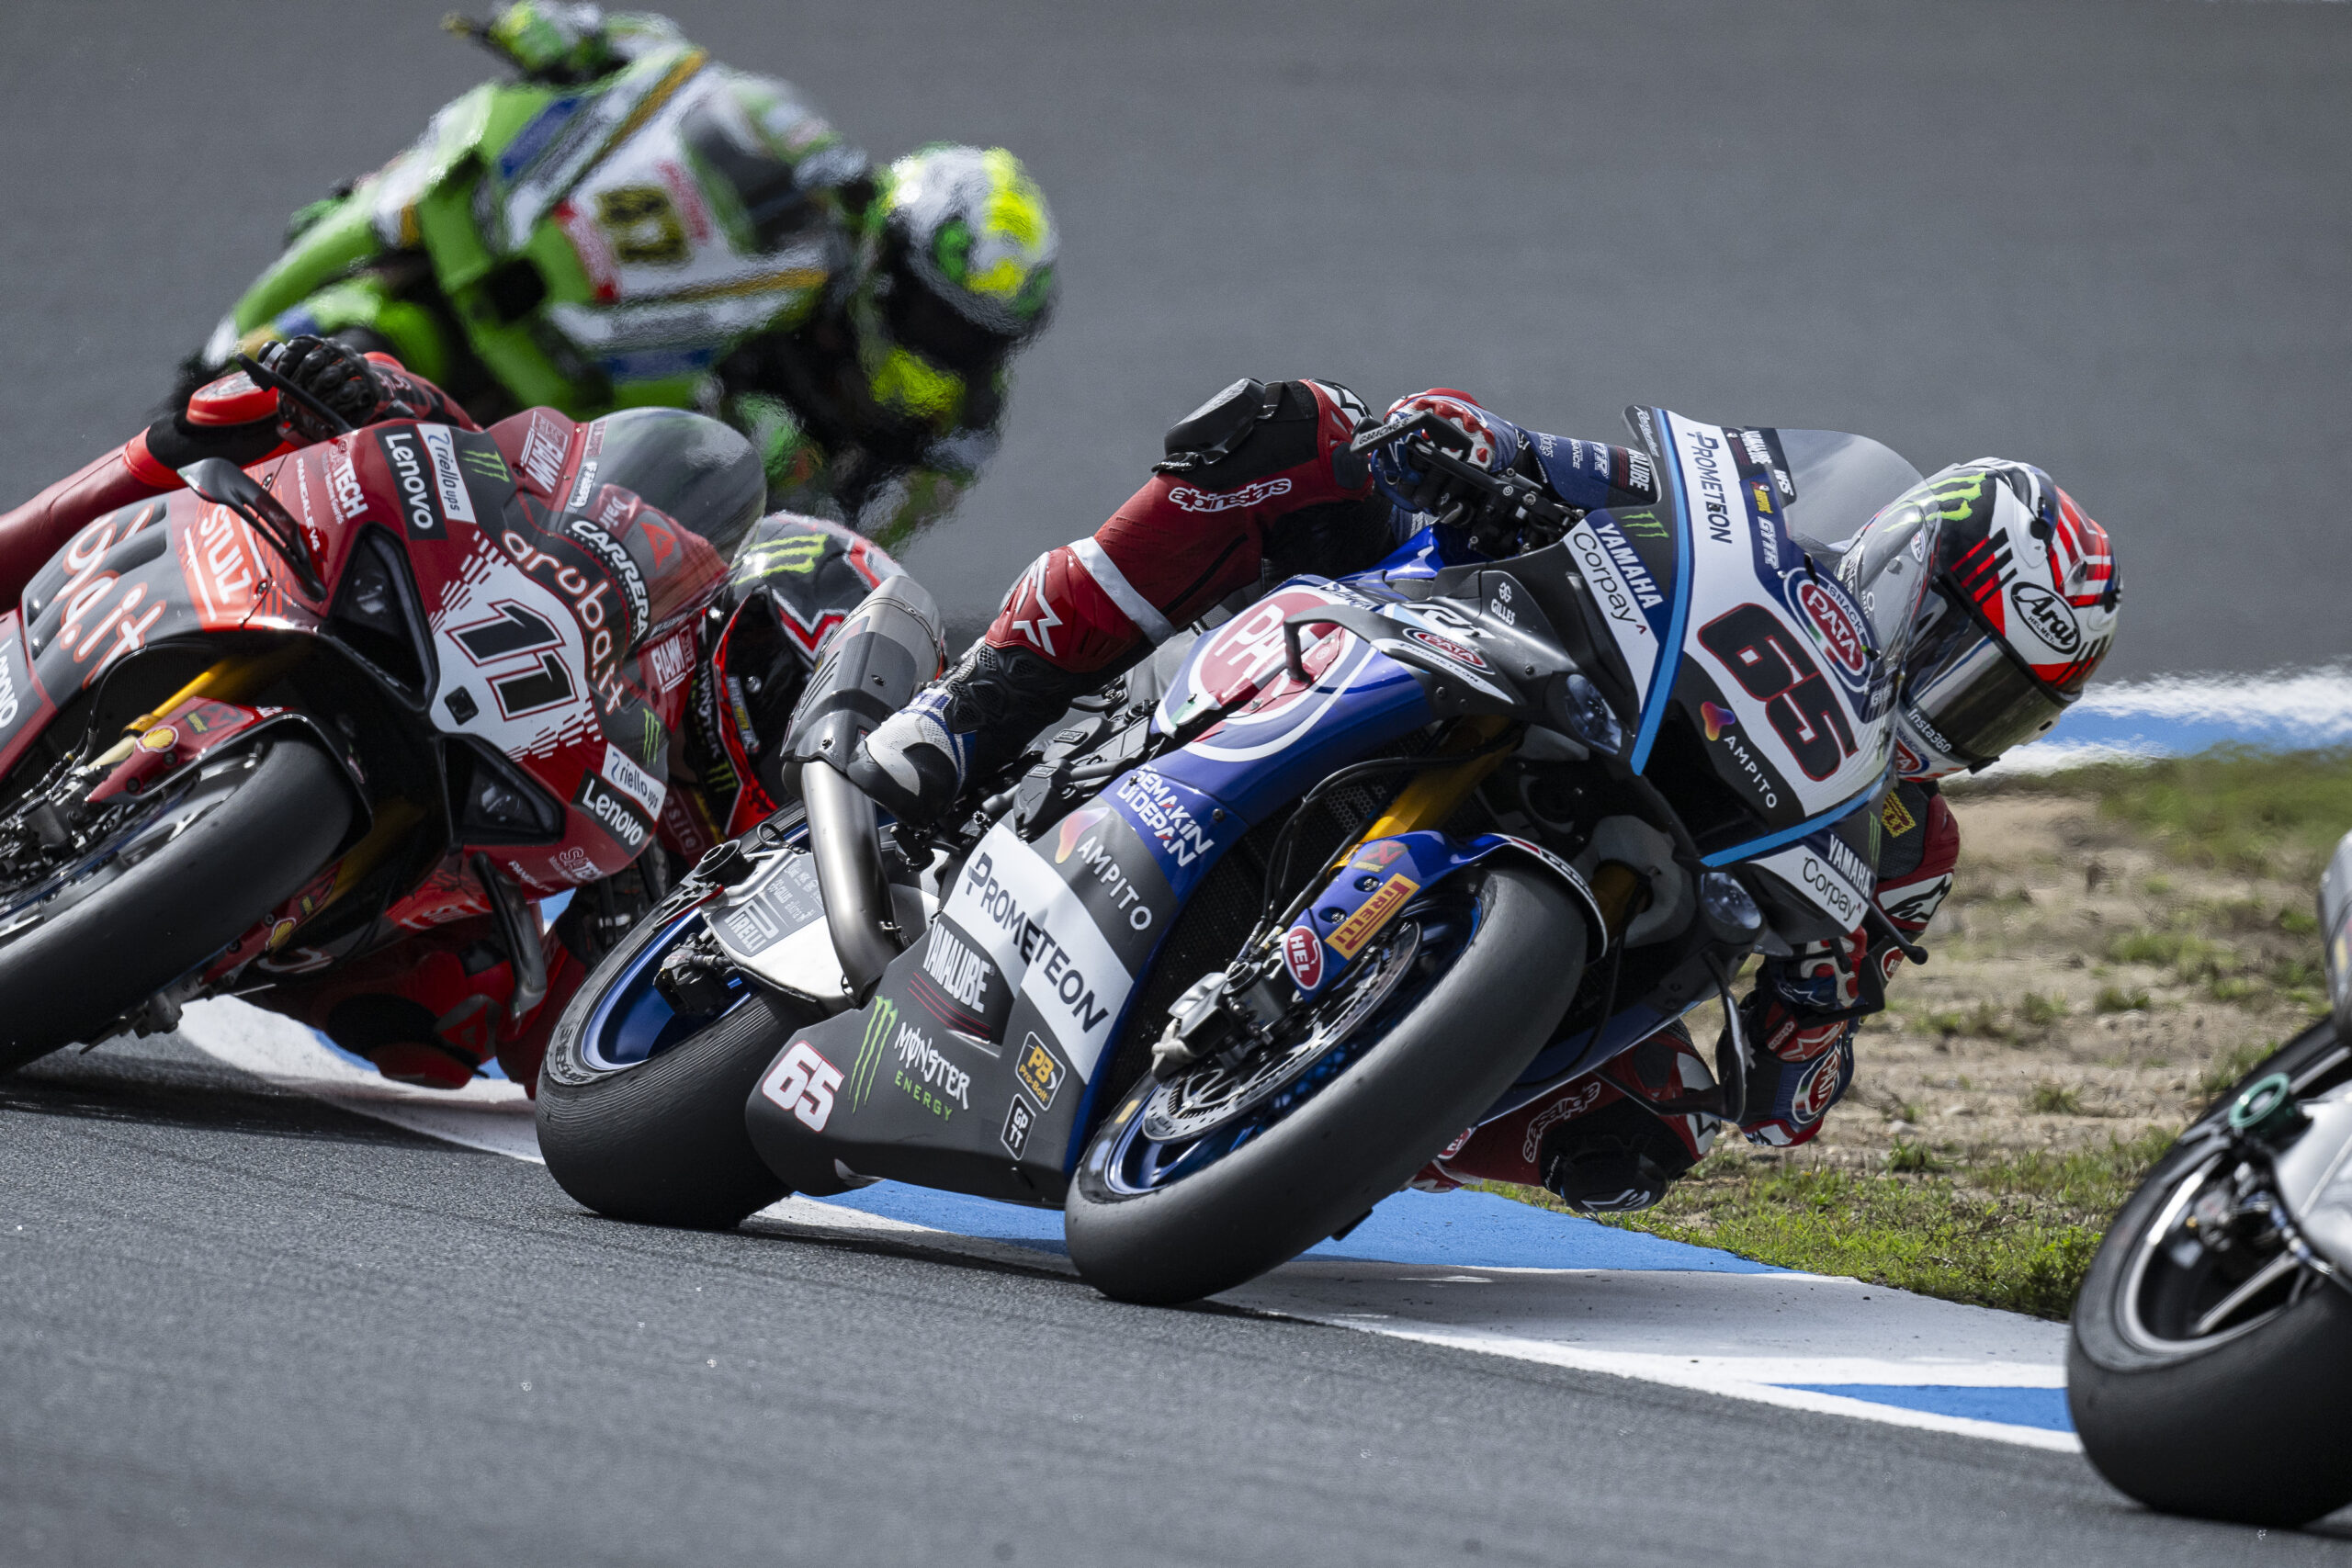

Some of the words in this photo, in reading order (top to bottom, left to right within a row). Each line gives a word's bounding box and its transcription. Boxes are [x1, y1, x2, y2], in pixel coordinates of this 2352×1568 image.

[296, 457, 315, 530] PANIGALE
[384, 433, 434, 530] Lenovo
[435, 442, 458, 491] riello
[446, 487, 460, 513] ups
[1168, 478, 1293, 513] alpinestars
[1687, 431, 1734, 544] PROMETEON
[1773, 468, 1793, 497] WRS
[200, 504, 253, 605] STULZ
[1595, 522, 1664, 610] YAMAHA
[1758, 516, 1781, 570] GYTR
[571, 519, 650, 638] CARRERA
[1572, 532, 1637, 623] Corpay
[1826, 584, 1864, 634] SNACK
[502, 530, 623, 714] aruba.it
[1491, 599, 1515, 626] GILLES
[1807, 591, 1857, 663] PATA
[2022, 590, 2080, 647] Arai
[446, 599, 579, 722] 11
[650, 634, 686, 687] FIAMM
[1400, 642, 1480, 683] PROMETEON
[1423, 633, 1477, 663] PATA
[1696, 602, 1860, 783] 65
[1907, 707, 1953, 755] Insta360
[619, 761, 648, 797] riello
[1723, 736, 1779, 809] AMPITO
[582, 779, 644, 846] Lenovo
[1076, 835, 1153, 931] AMPITO
[1802, 856, 1857, 923] Corpay
[1829, 833, 1873, 899] YAMAHA
[723, 897, 780, 954] PIRELLI
[966, 851, 1110, 1034] PROMETEON
[1334, 878, 1411, 952] PIRELLI
[922, 919, 992, 1013] YAMALUBE
[1288, 933, 1308, 980] HEL
[761, 1039, 845, 1134] 65
[894, 1021, 971, 1111] MONSTER
[894, 1069, 955, 1122] ENERGY
[1018, 1065, 1049, 1104] Pro-Bolt
[1027, 1044, 1055, 1086] PB
